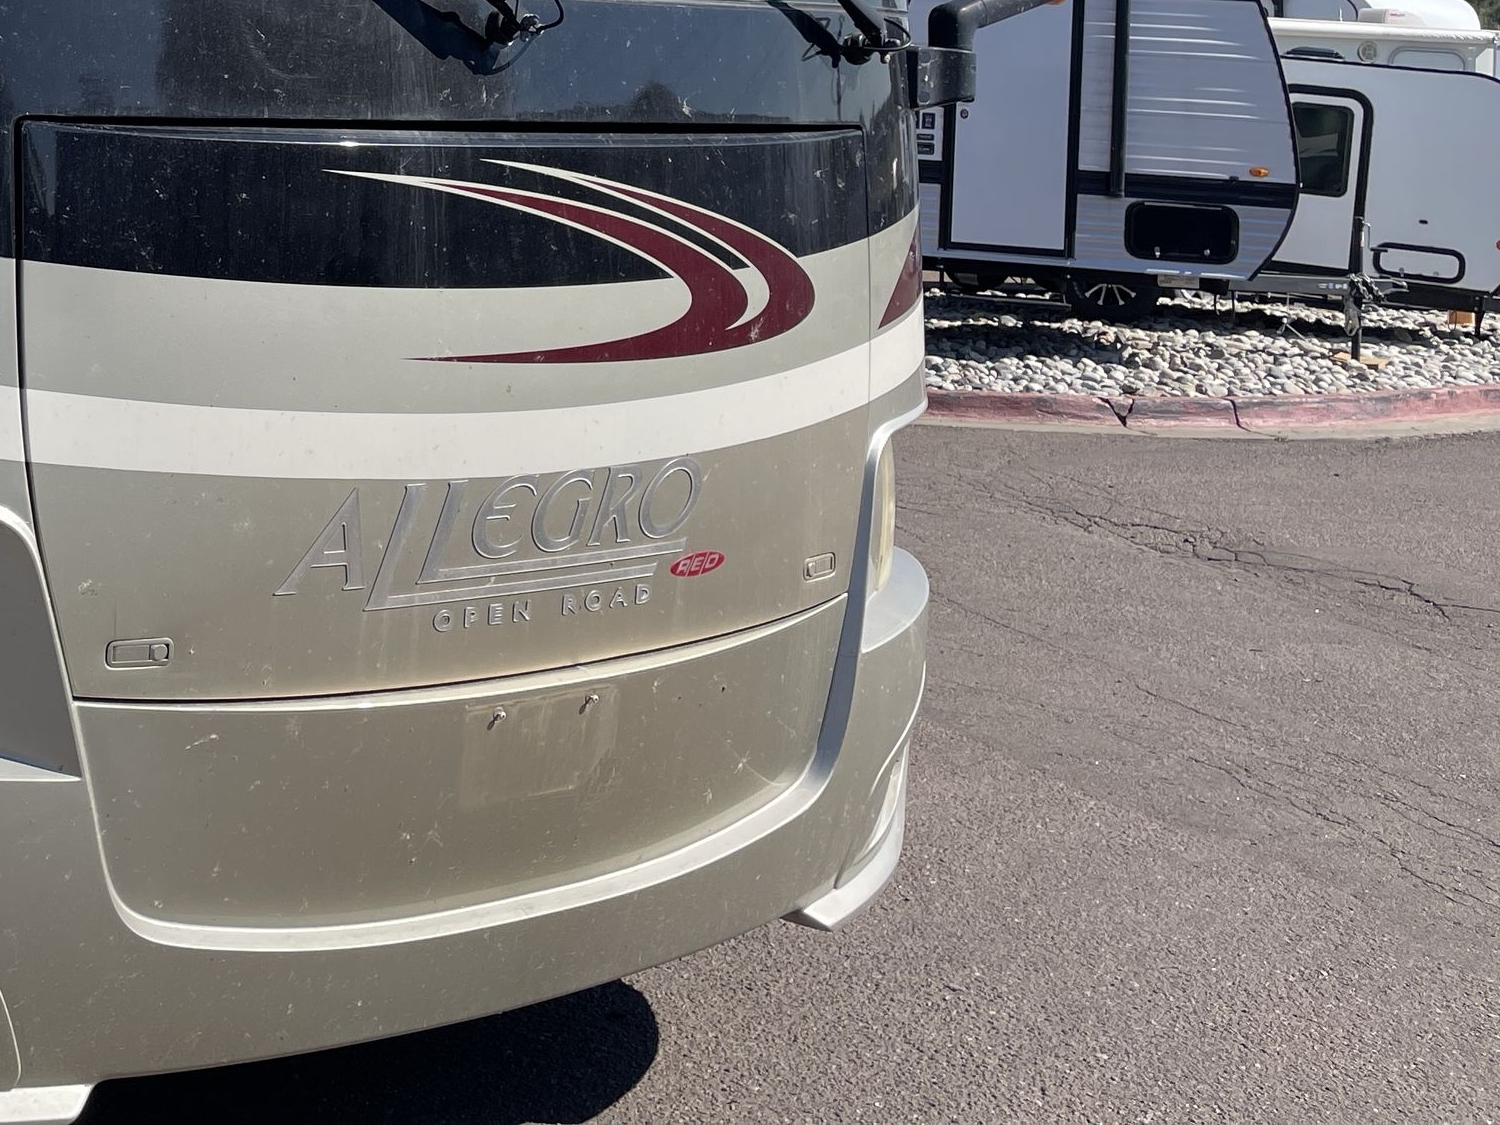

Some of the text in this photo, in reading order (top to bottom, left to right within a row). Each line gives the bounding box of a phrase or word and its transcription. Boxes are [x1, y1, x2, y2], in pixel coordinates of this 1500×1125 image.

[273, 457, 700, 611] ALLEGRO
[433, 584, 651, 632] OPEN ROAD
